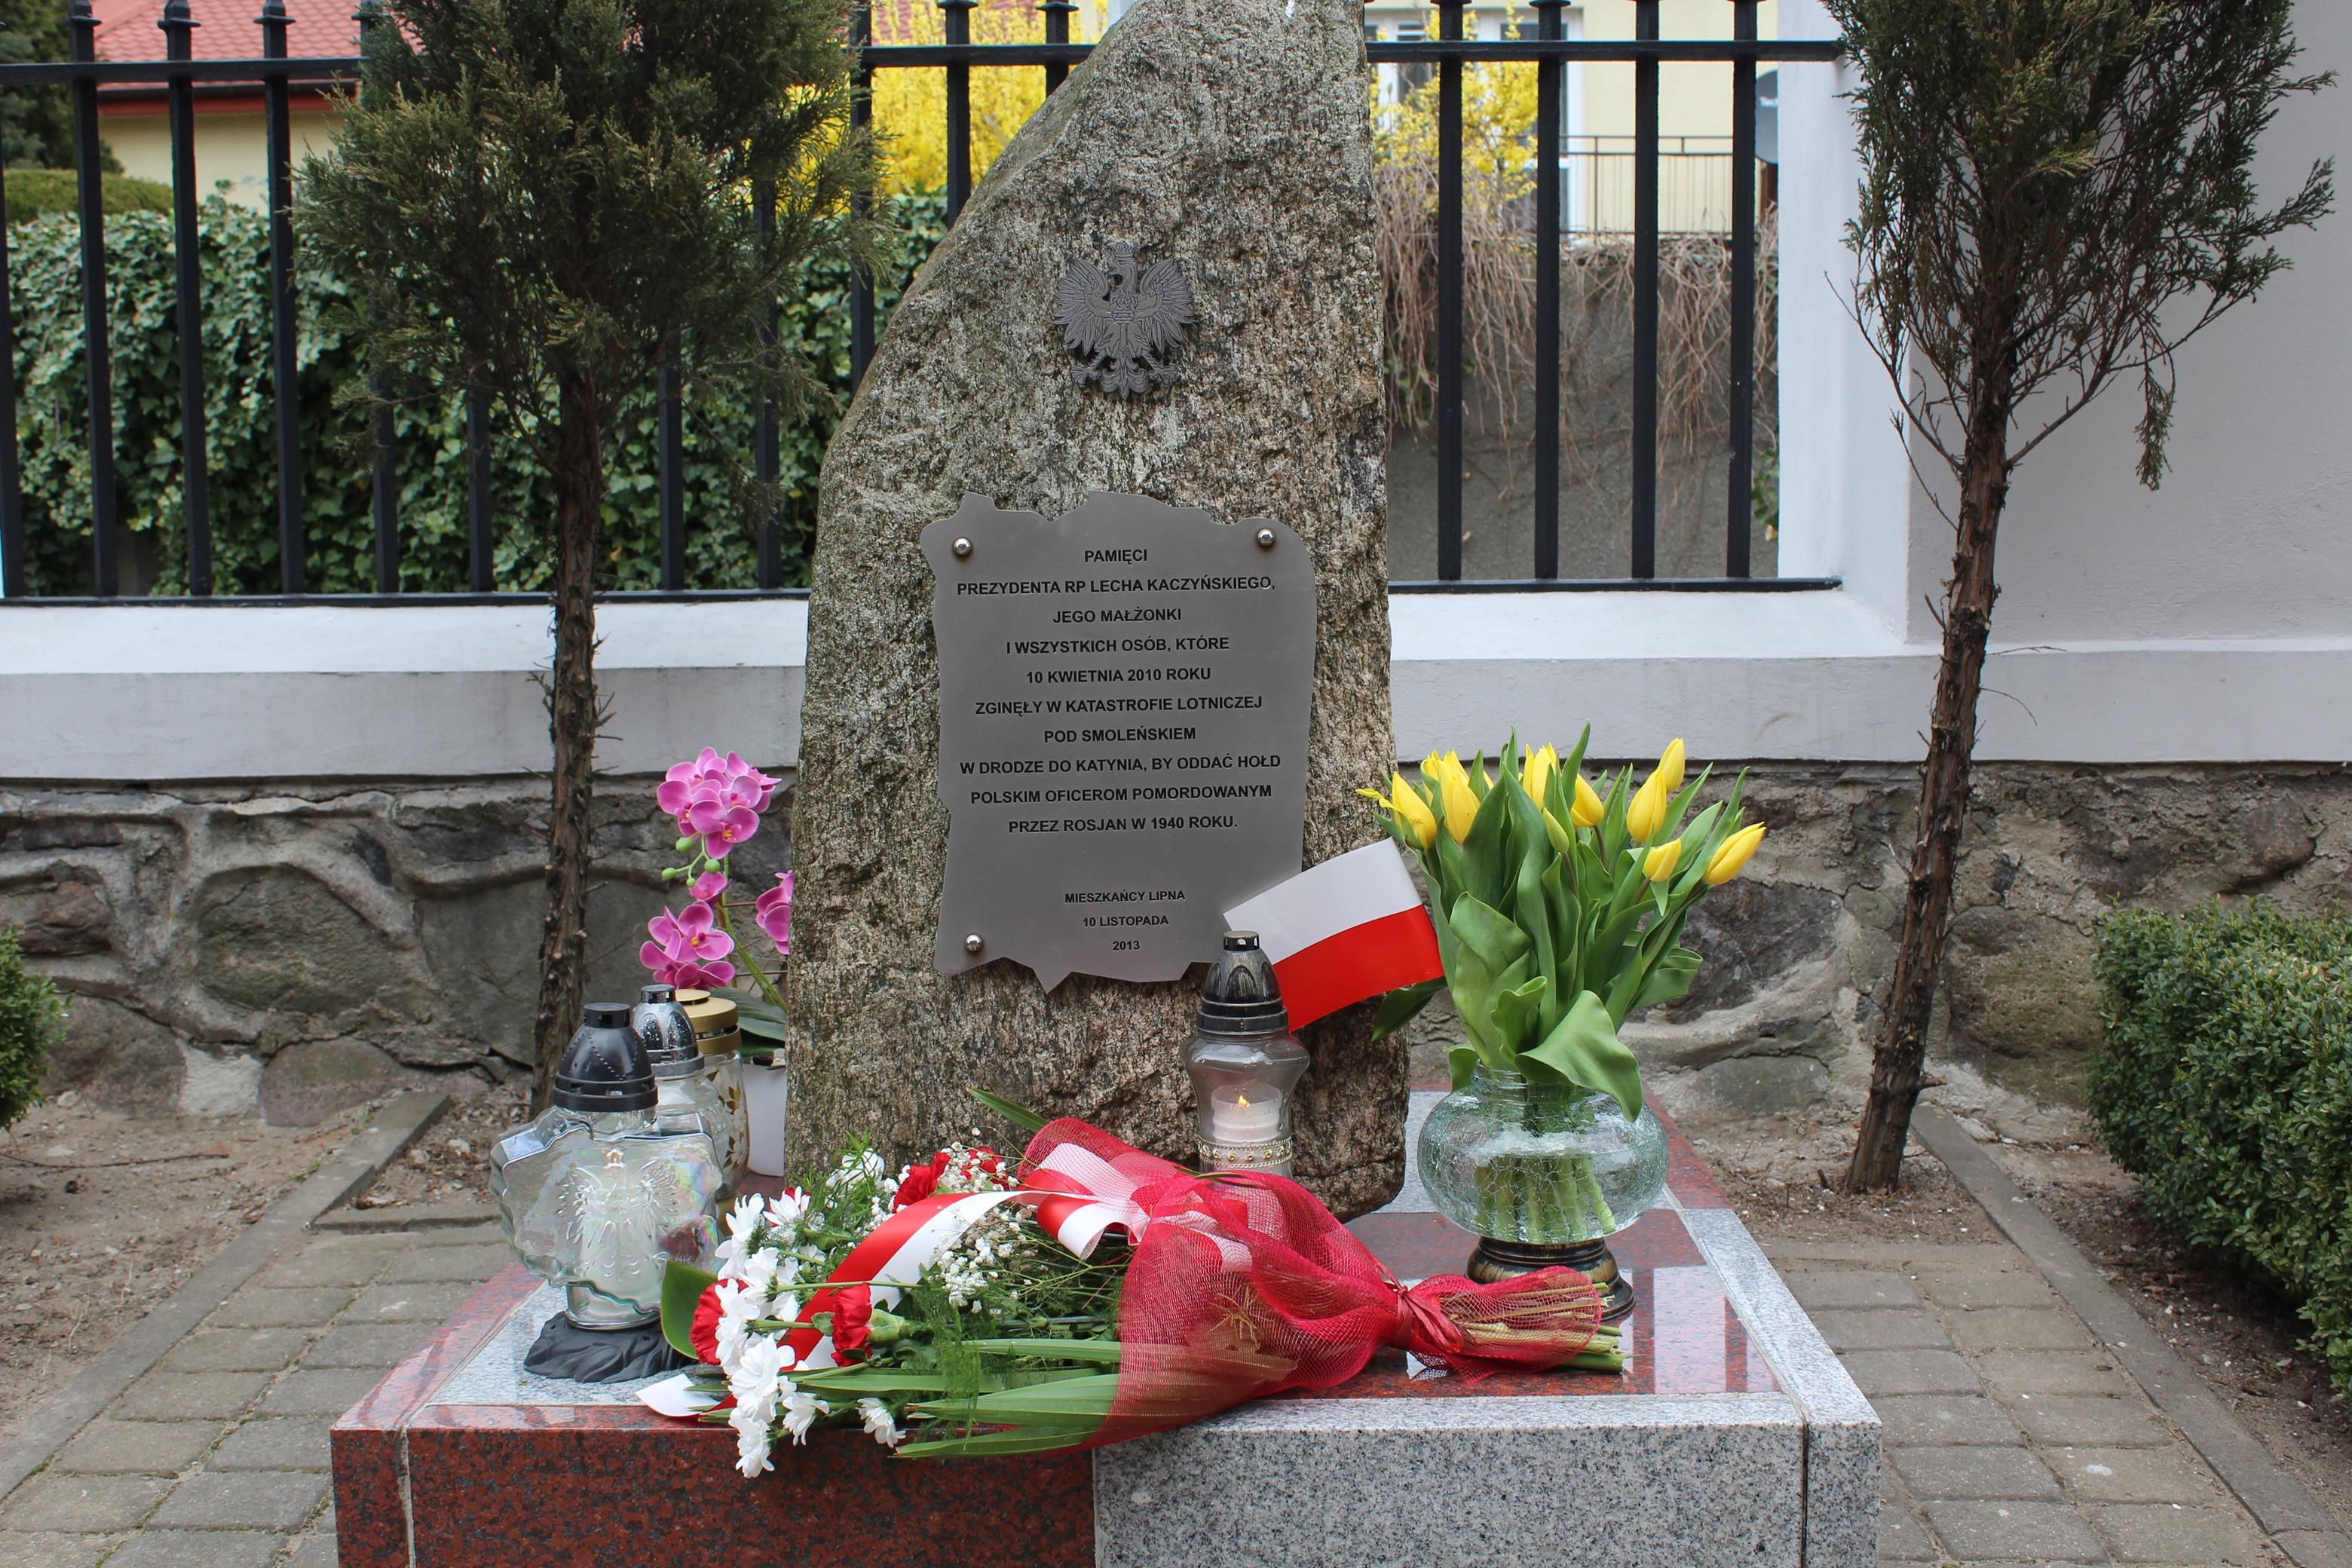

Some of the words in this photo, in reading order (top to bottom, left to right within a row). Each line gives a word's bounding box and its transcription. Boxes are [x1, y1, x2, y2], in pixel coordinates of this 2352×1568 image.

[1084, 548, 1147, 565] PAMIĘCI
[957, 580, 1061, 596] PREZYDENTA
[1064, 580, 1086, 593] RP
[1090, 579, 1144, 593] LECHA
[1147, 574, 1276, 592] KACZYŃSKIEGO,
[1052, 610, 1096, 623] JEGO
[1100, 606, 1181, 622] MAŁŻONKI
[1006, 642, 1011, 654] I
[1014, 639, 1117, 654] WSZYSTKICH
[1121, 635, 1171, 653] OSÓB,
[1175, 634, 1230, 651] KTÓRE
[1026, 671, 1043, 684] 10
[1047, 669, 1124, 684] KWIETNIA
[1127, 668, 1162, 681] 2010
[1166, 667, 1211, 681] ROKU
[975, 700, 1043, 718] ZGINĘŁY
[1046, 700, 1062, 713] W
[1065, 697, 1173, 713] KATASTROFIE
[1178, 696, 1262, 710] LOTNICZEJ
[1044, 730, 1077, 743] POD
[1082, 724, 1196, 743] SMOLEŃSKIEM
[959, 761, 975, 775] W
[979, 760, 1044, 774] DRODZE
[1049, 759, 1072, 773] DO
[1076, 758, 1147, 773] KATYNIA,
[1151, 757, 1173, 770] BY
[1177, 752, 1233, 770] ODDAĆ
[1238, 755, 1281, 768] HOŁD
[971, 790, 1040, 804] POLSKIM
[1045, 788, 1128, 802] OFICEROM
[1132, 784, 1272, 801] POMORDOWANYM
[1009, 819, 1059, 833] PRZEZ
[1063, 818, 1127, 831] ROSJAN
[1131, 817, 1147, 830] W
[1150, 816, 1184, 830] 1940
[1189, 815, 1238, 828] ROKU.
[1064, 889, 1146, 903] MIESZKAŃCY
[1149, 890, 1186, 901] LIPNA
[1083, 917, 1096, 927] 10
[1099, 915, 1169, 926] LISTOPADA
[1113, 940, 1141, 951] 2013
